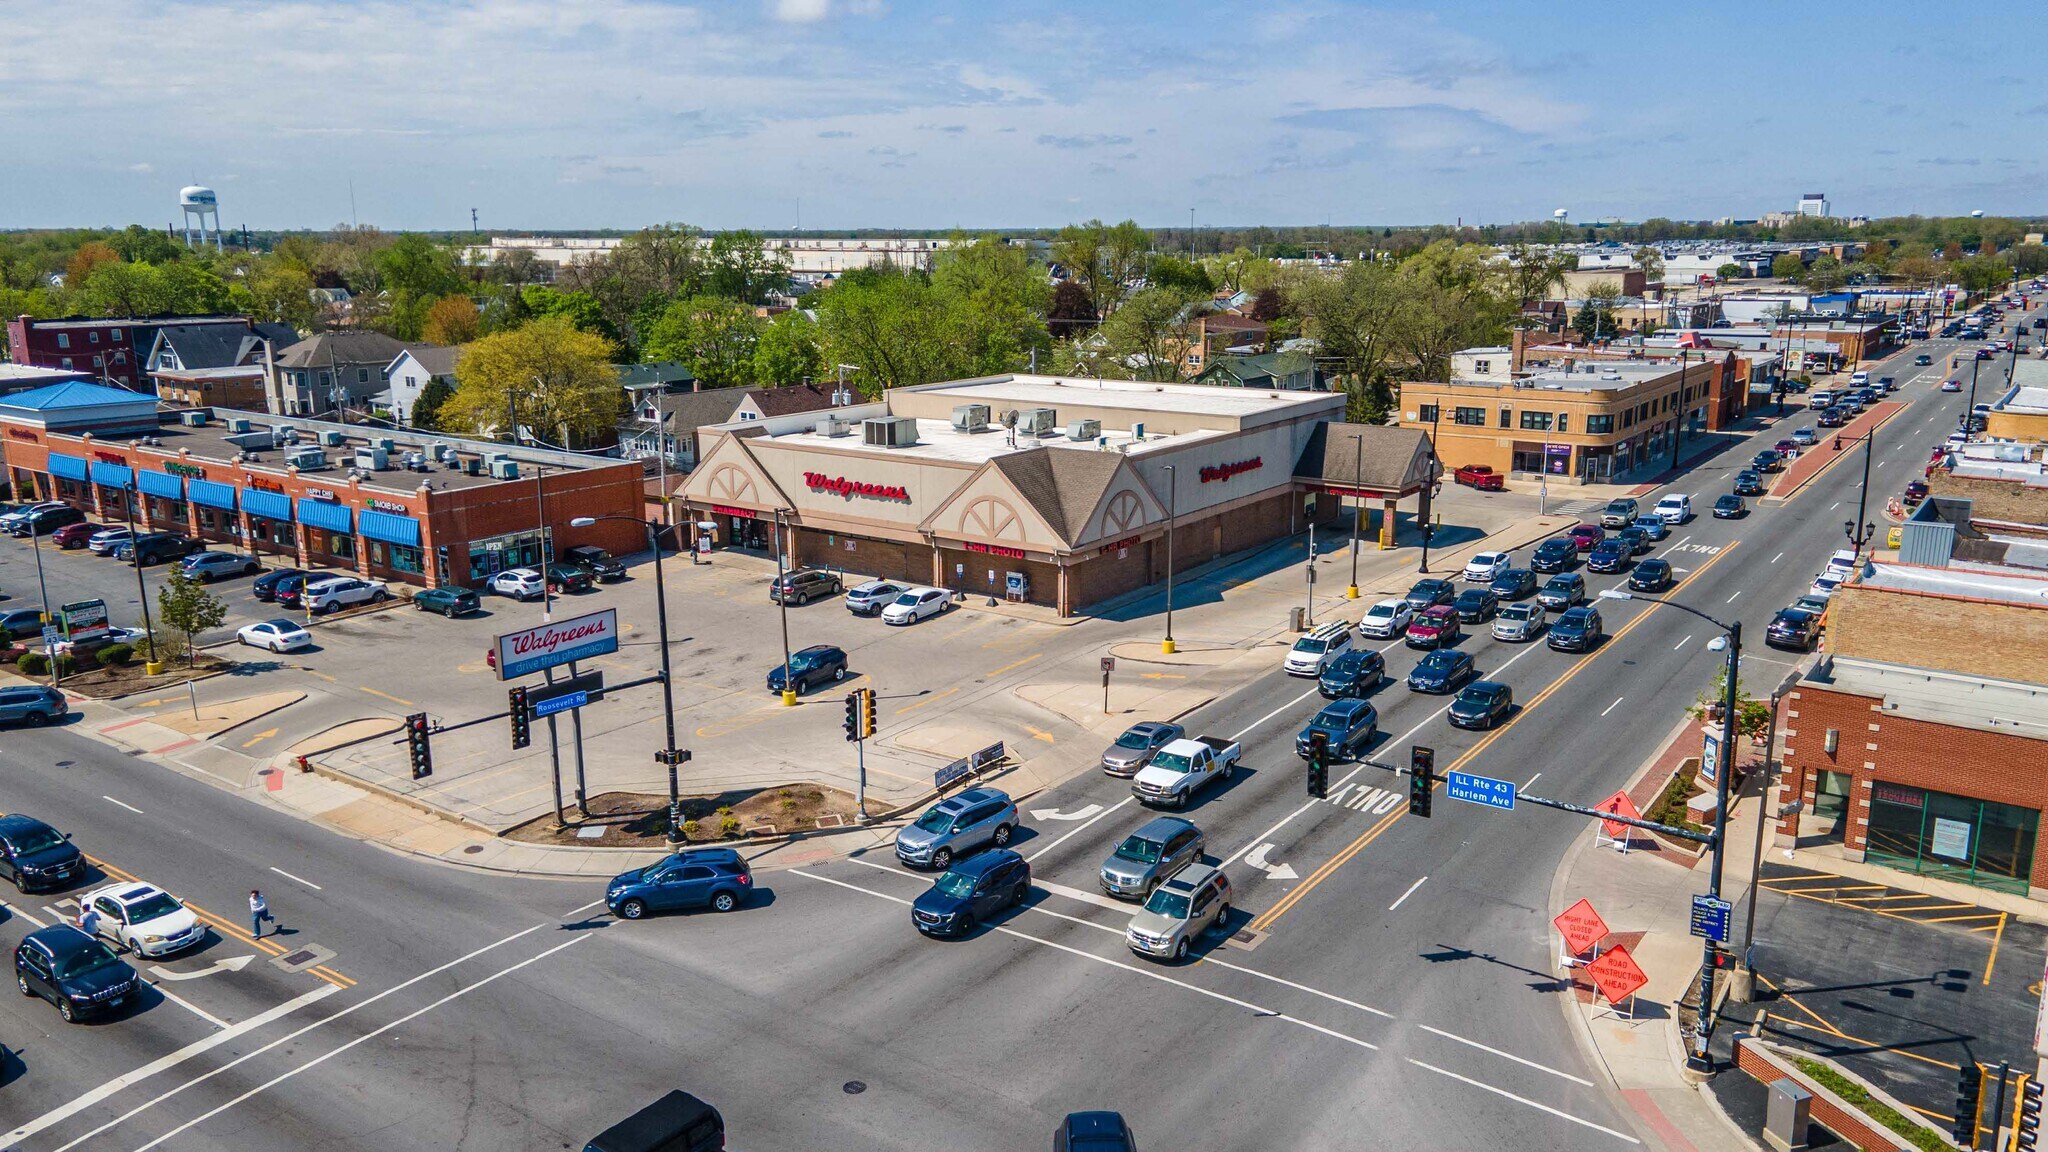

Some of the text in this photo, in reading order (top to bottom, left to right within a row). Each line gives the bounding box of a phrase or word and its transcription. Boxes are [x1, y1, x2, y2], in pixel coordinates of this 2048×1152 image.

[803, 472, 909, 499] Walgreens
[392, 503, 406, 511] SHOP
[1119, 535, 1141, 550] PHOTO
[1675, 544, 1720, 554] ONLY
[990, 545, 1025, 560] PHOTO
[47, 636, 58, 644] 43
[512, 620, 606, 655] Walgreens
[516, 641, 605, 673] drive thru pharmacy
[538, 694, 586, 713] Roosevelt Rd
[1455, 775, 1508, 793] ILL Rte 43
[1322, 782, 1403, 815] ONLY
[1452, 786, 1510, 806] Harlem Ave
[1564, 915, 1599, 928] RIGHT LANE
[1569, 924, 1593, 935] CLOSED
[1570, 932, 1590, 942] AHEAD
[1608, 958, 1628, 969] ROAD
[1590, 965, 1644, 984] CONSTRUCTION
[1603, 979, 1628, 991] AHEAD
